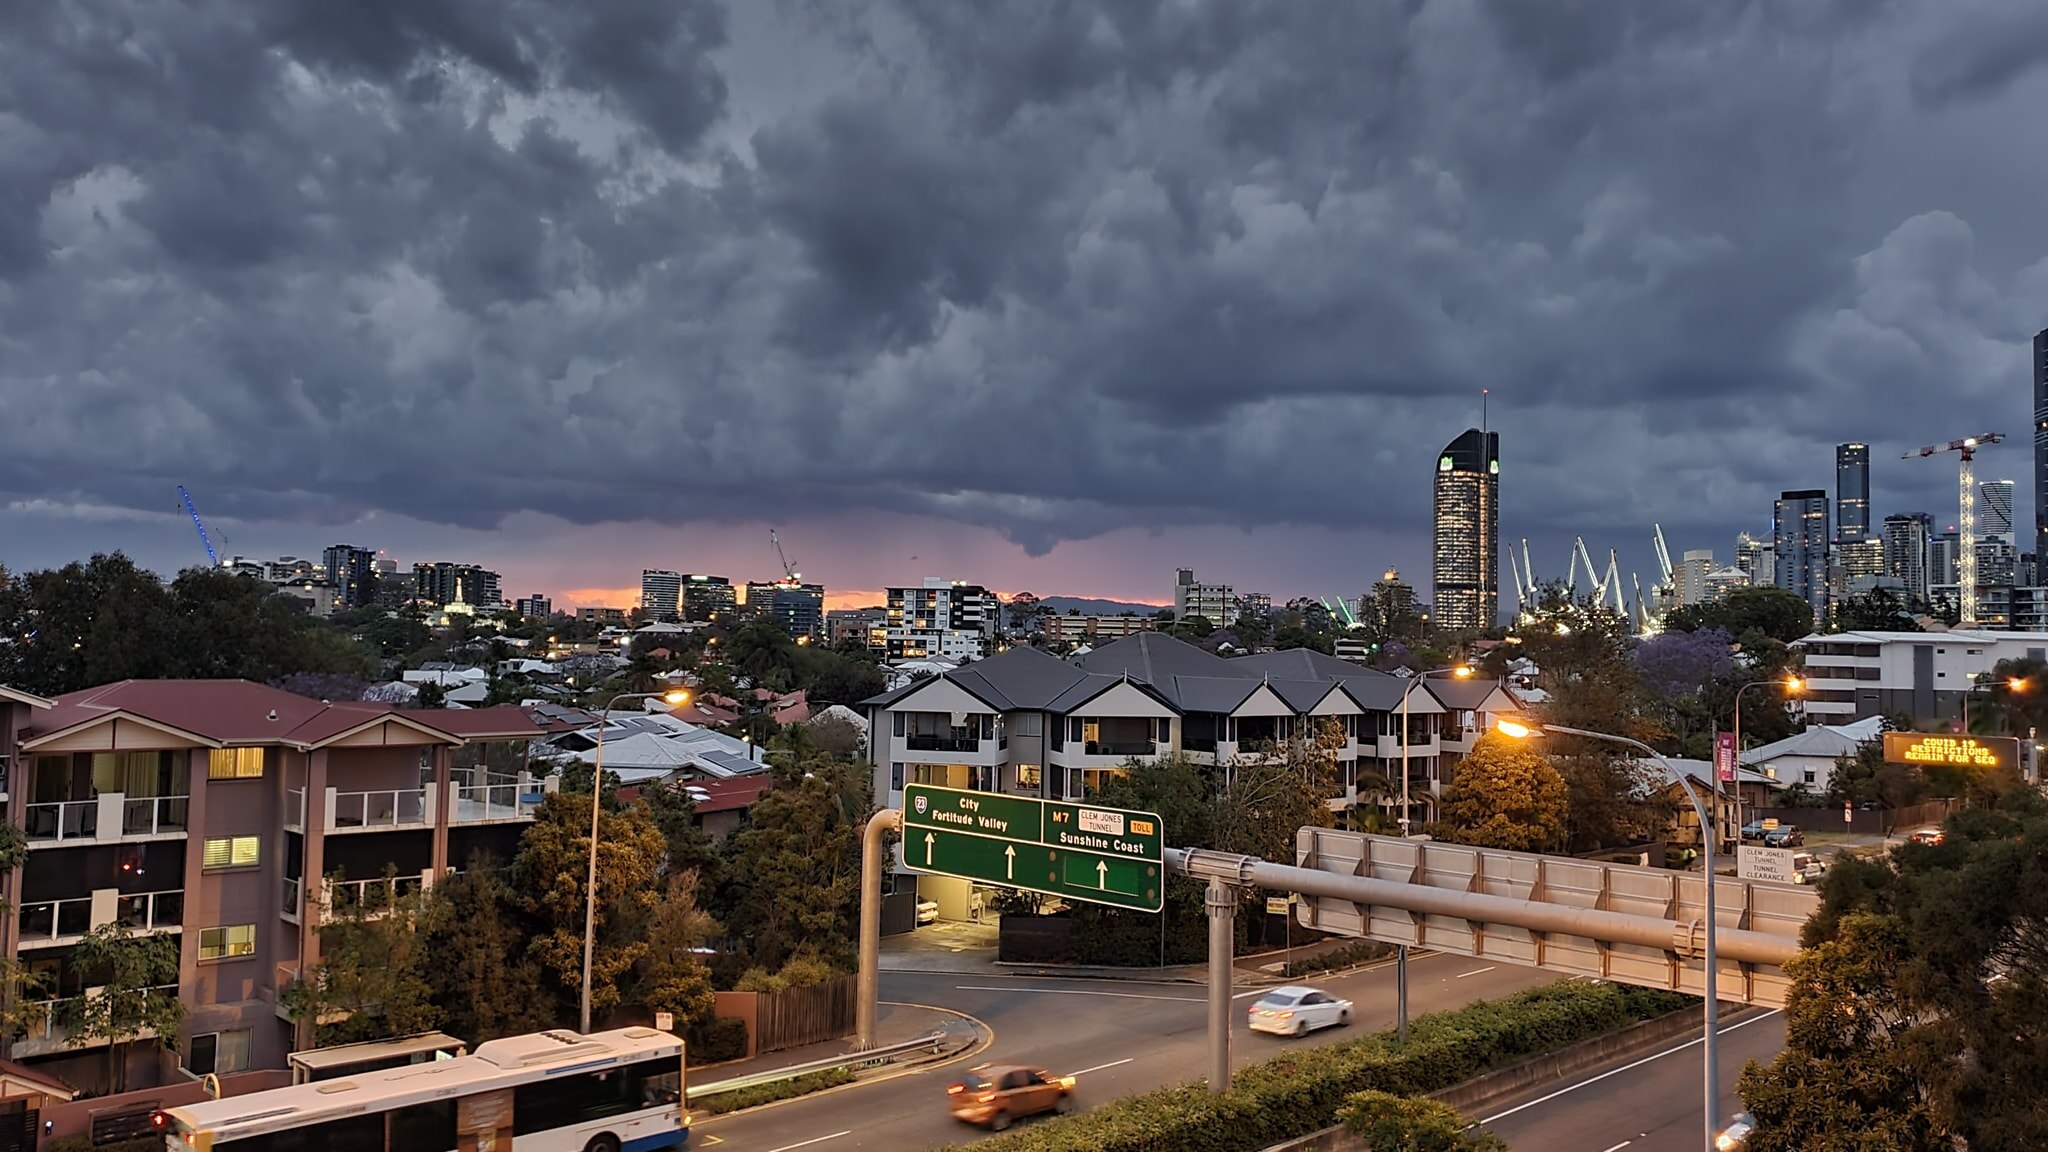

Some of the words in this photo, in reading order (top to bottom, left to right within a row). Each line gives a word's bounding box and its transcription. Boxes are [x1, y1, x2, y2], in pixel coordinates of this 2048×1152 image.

[1923, 738, 1956, 748] COVID
[1962, 740, 1976, 748] 19
[1911, 744, 1989, 756] RESTRICTIONS
[1905, 751, 1944, 762] REMAIN
[1948, 754, 1969, 763] FOR
[1974, 755, 1996, 765] SEQ
[917, 798, 925, 810] 23
[959, 797, 979, 812] City
[932, 809, 973, 825] Fortitude
[978, 816, 1008, 832] Valley
[1052, 811, 1070, 823] M7
[1080, 811, 1098, 821] CLEM
[1101, 814, 1122, 823] JONES
[1088, 822, 1113, 833] TUNNEL
[1133, 822, 1151, 833] TOLL
[1060, 831, 1108, 849] Sunshine
[1113, 839, 1144, 854] Coast
[1754, 857, 1777, 865] TUNNEL
[1753, 864, 1778, 873] TUNNEL
[1746, 871, 1785, 881] CLEARANCE
